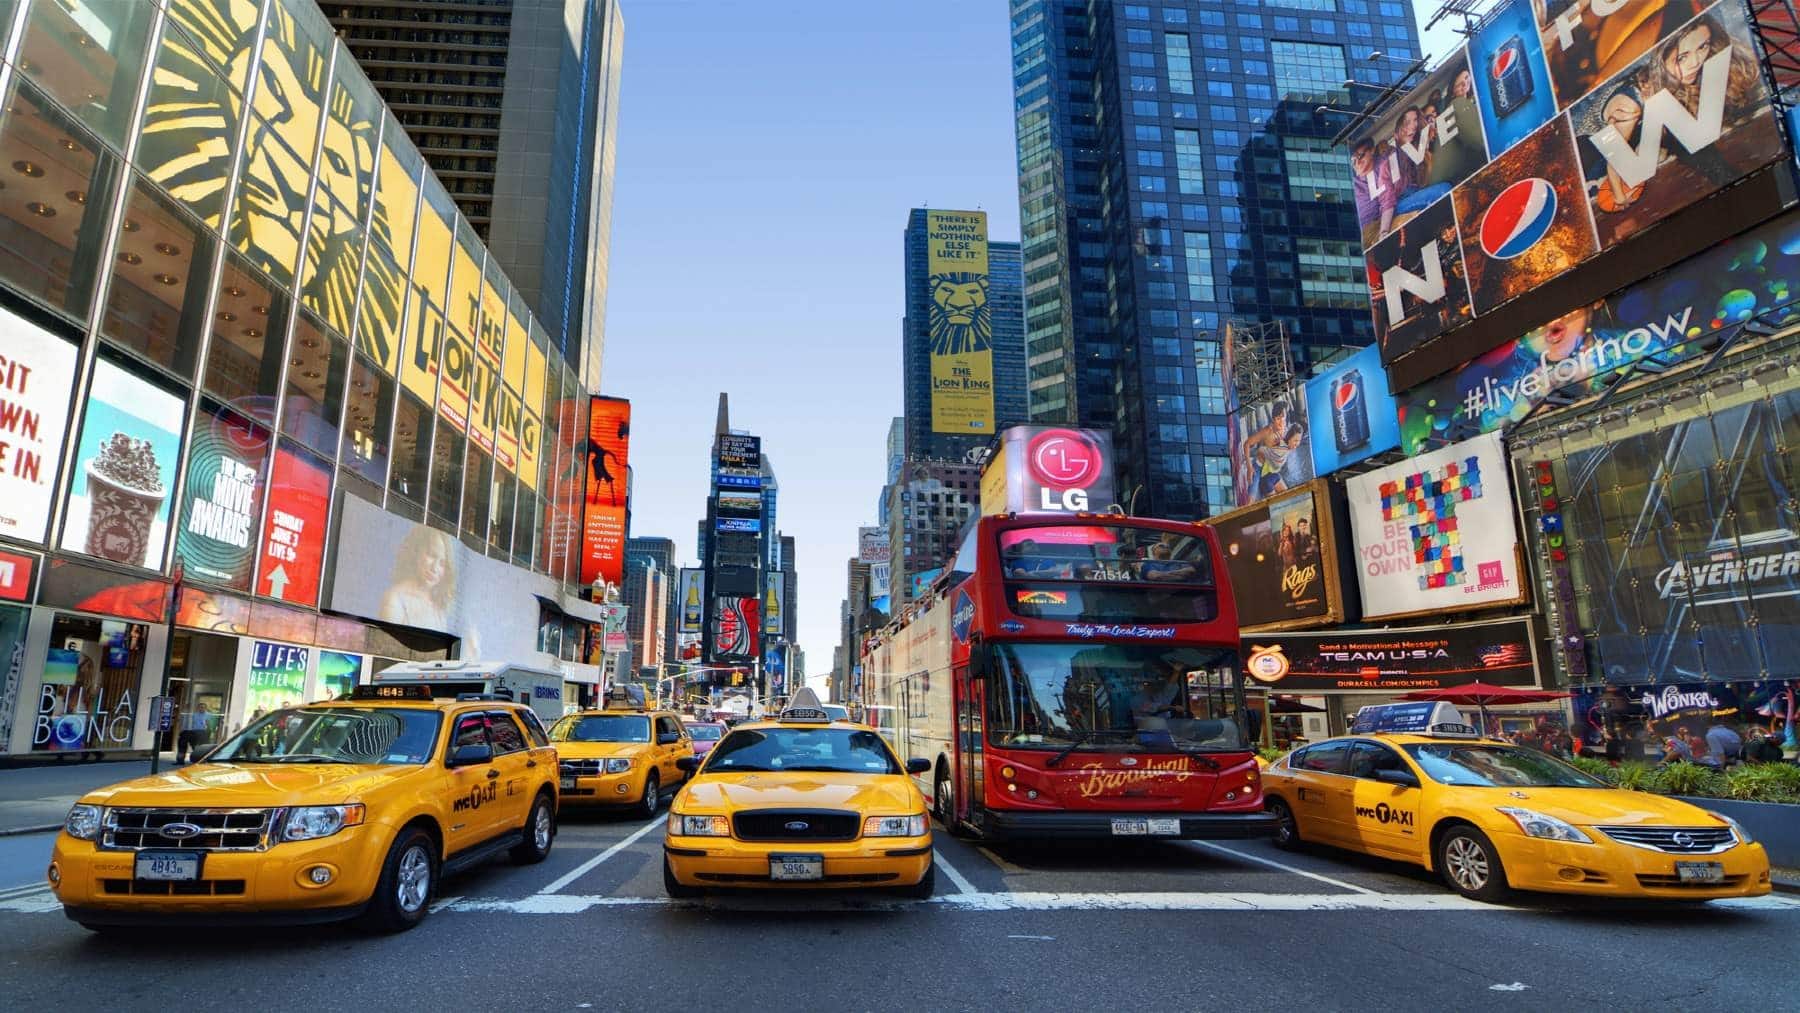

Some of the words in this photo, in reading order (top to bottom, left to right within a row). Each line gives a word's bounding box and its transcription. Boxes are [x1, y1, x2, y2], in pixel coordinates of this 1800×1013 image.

[1366, 104, 1459, 201] LIVE
[938, 223, 976, 233] SIMPLY
[970, 216, 980, 224] IS
[930, 232, 984, 242] NOTHING
[945, 241, 970, 250] ELSE
[937, 249, 962, 259] LIKE
[952, 367, 972, 376] THE
[1462, 306, 1693, 421] #livefornow
[483, 360, 534, 453] KING
[1041, 487, 1089, 512] LG
[188, 497, 251, 549] AWARDS
[1383, 521, 1407, 540] BE
[1360, 539, 1409, 561] YOUR
[1367, 556, 1411, 577] OWN
[1281, 564, 1317, 599] Rags
[1464, 585, 1475, 594] BE
[1065, 623, 1094, 638] Truly
[1095, 624, 1112, 634] The
[1111, 625, 1137, 636] Local
[1137, 627, 1176, 638] Expert!
[1319, 651, 1385, 662] TEAM
[1320, 643, 1340, 651] Send
[1349, 642, 1400, 651] Motivational
[1402, 641, 1439, 650] Message
[252, 643, 308, 672] LIFE'S
[250, 671, 289, 688] BETTER
[39, 684, 133, 715] BILLA
[1641, 685, 1719, 718] WONKA
[34, 715, 133, 745] BONG
[1080, 757, 1194, 798] Broadway
